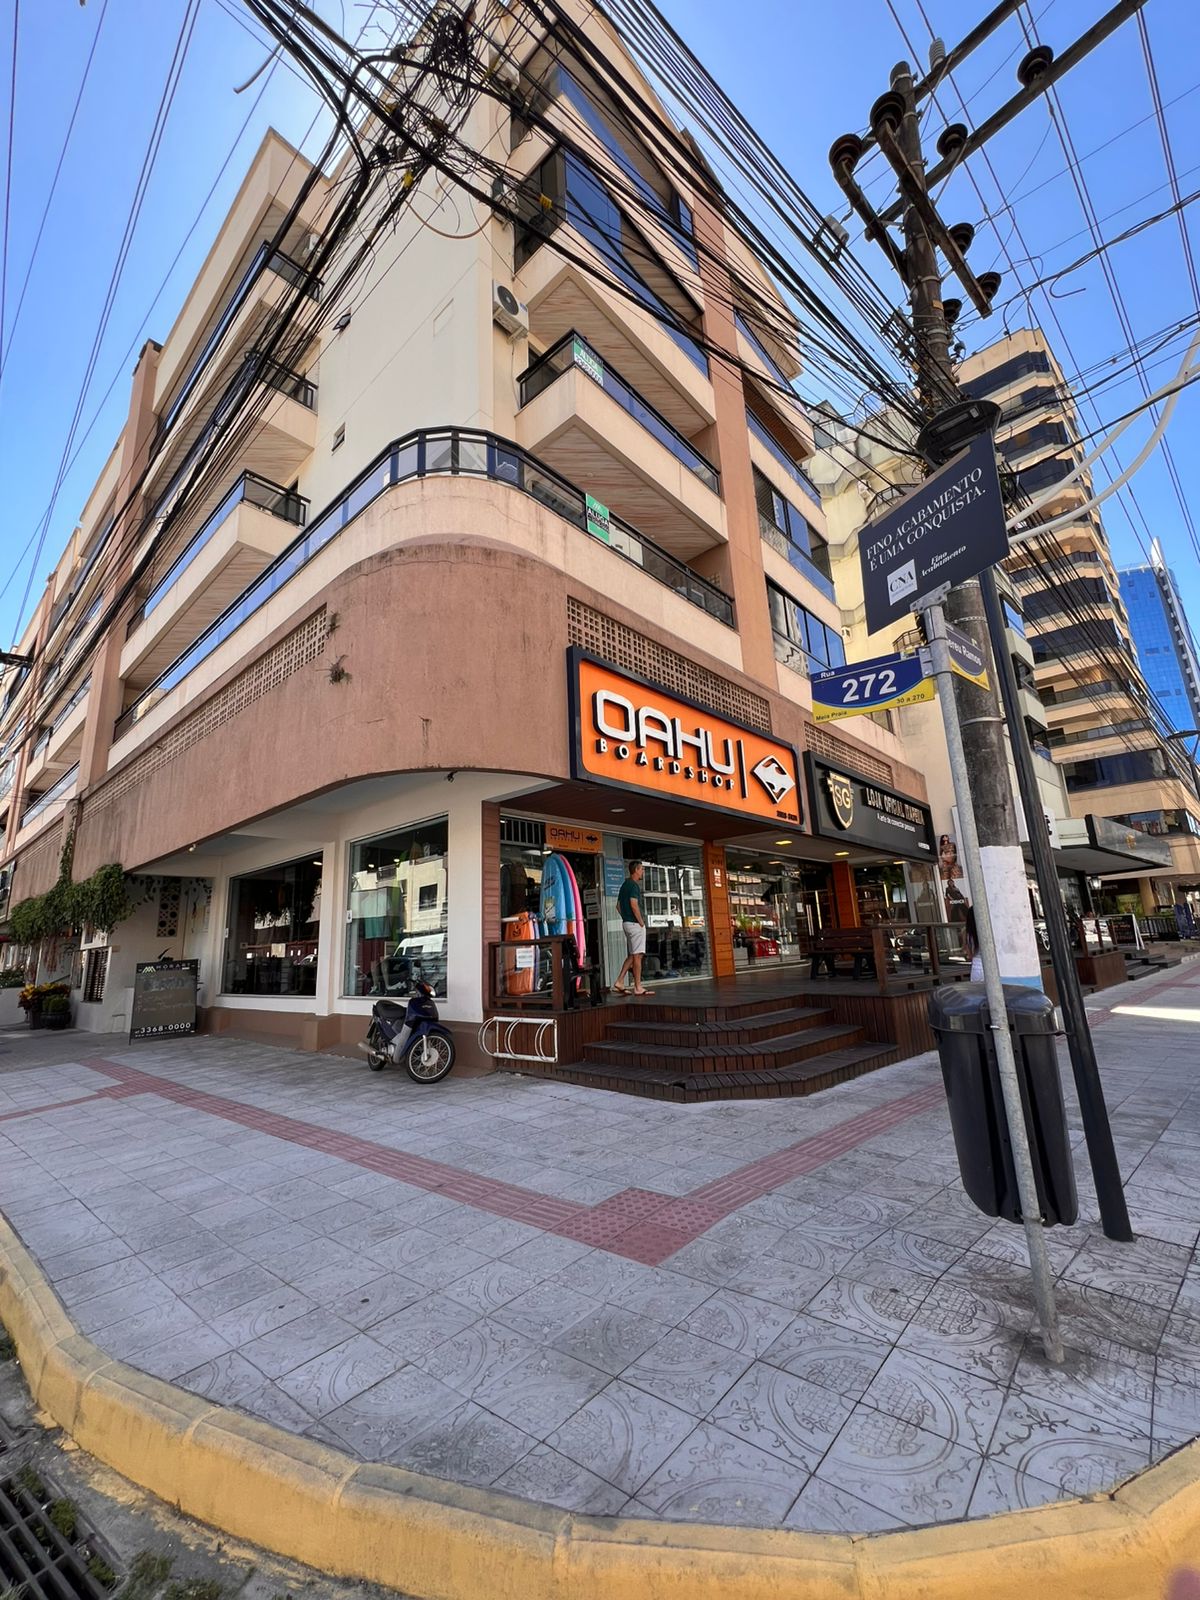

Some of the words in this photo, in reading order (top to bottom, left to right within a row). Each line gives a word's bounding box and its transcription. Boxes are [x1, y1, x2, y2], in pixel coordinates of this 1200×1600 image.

[587, 507, 609, 526] ALUGA
[866, 534, 893, 560] FINO
[895, 467, 982, 540] ACABAMENTO
[870, 556, 878, 571] É
[879, 541, 904, 565] UMA
[906, 486, 986, 545] CONQUISTA.
[931, 551, 948, 566] Fino
[889, 571, 914, 593] CNA
[961, 645, 982, 666] Ramos
[820, 671, 835, 679] Rua
[842, 669, 897, 703] 272
[912, 693, 925, 701] 270
[831, 710, 848, 719] Praia
[592, 689, 735, 775] OAHU
[596, 738, 735, 790] BOARDSHOP
[834, 784, 851, 809] SG
[866, 787, 883, 810] LOJA
[883, 795, 905, 819] OFICIAL
[550, 828, 580, 840] OAHU
[140, 1022, 191, 1034] 3368-0000
